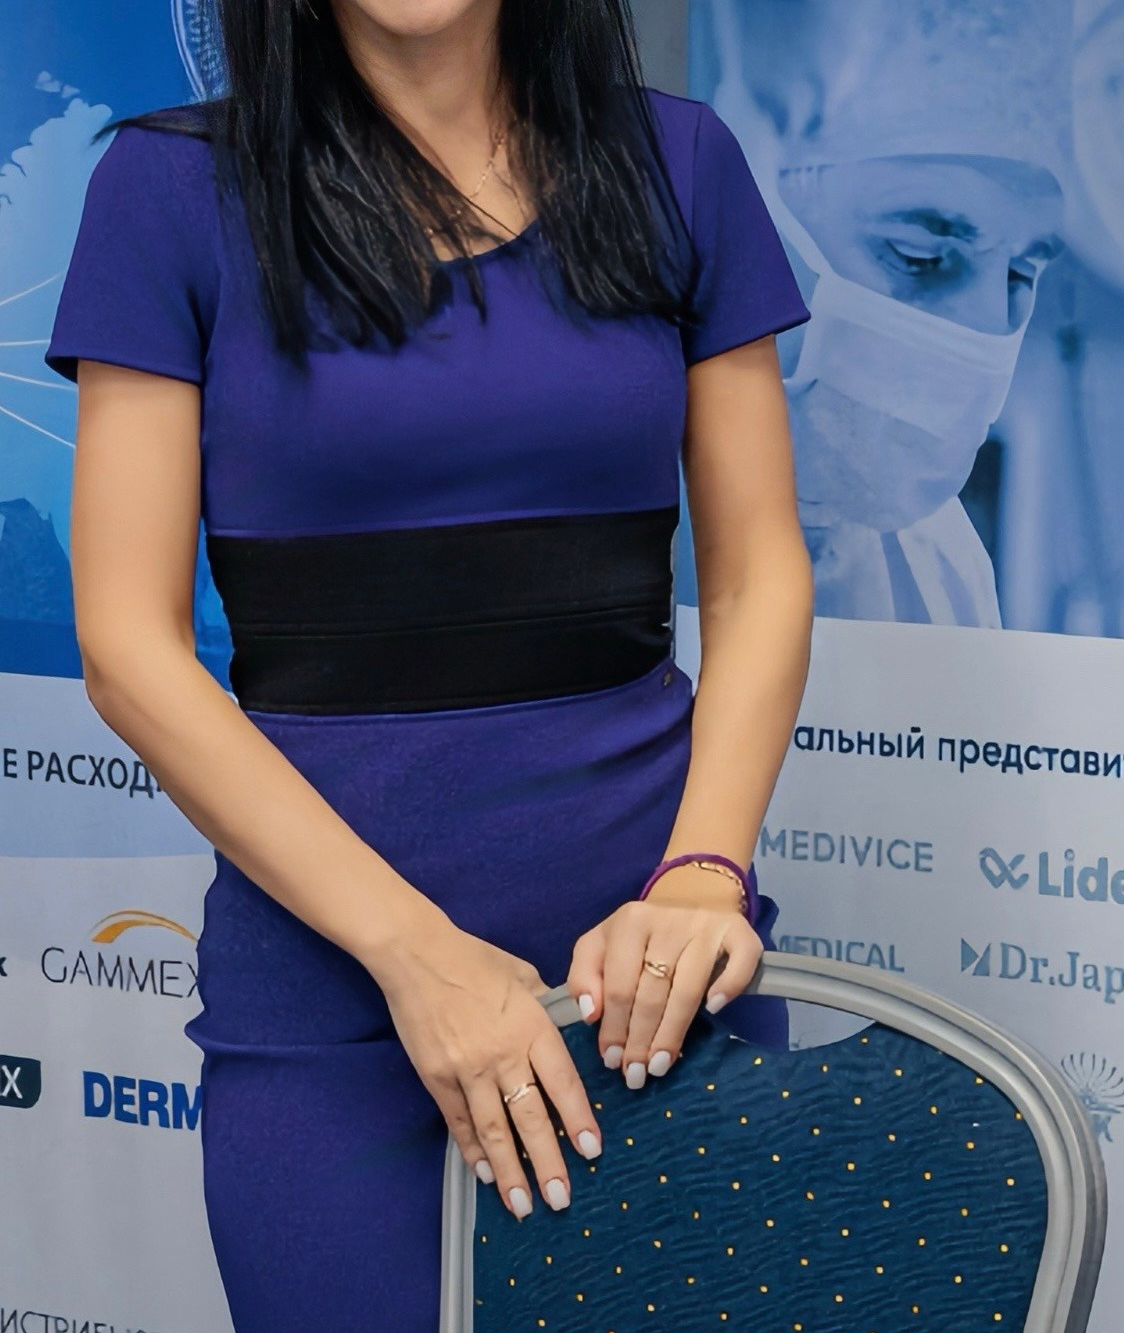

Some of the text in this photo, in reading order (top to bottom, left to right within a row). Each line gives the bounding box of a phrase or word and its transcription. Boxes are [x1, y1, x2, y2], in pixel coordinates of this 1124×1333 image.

[794, 726, 924, 760] альный
[27, 750, 161, 799] РАСХОД
[760, 827, 933, 873] MEDIVICE
